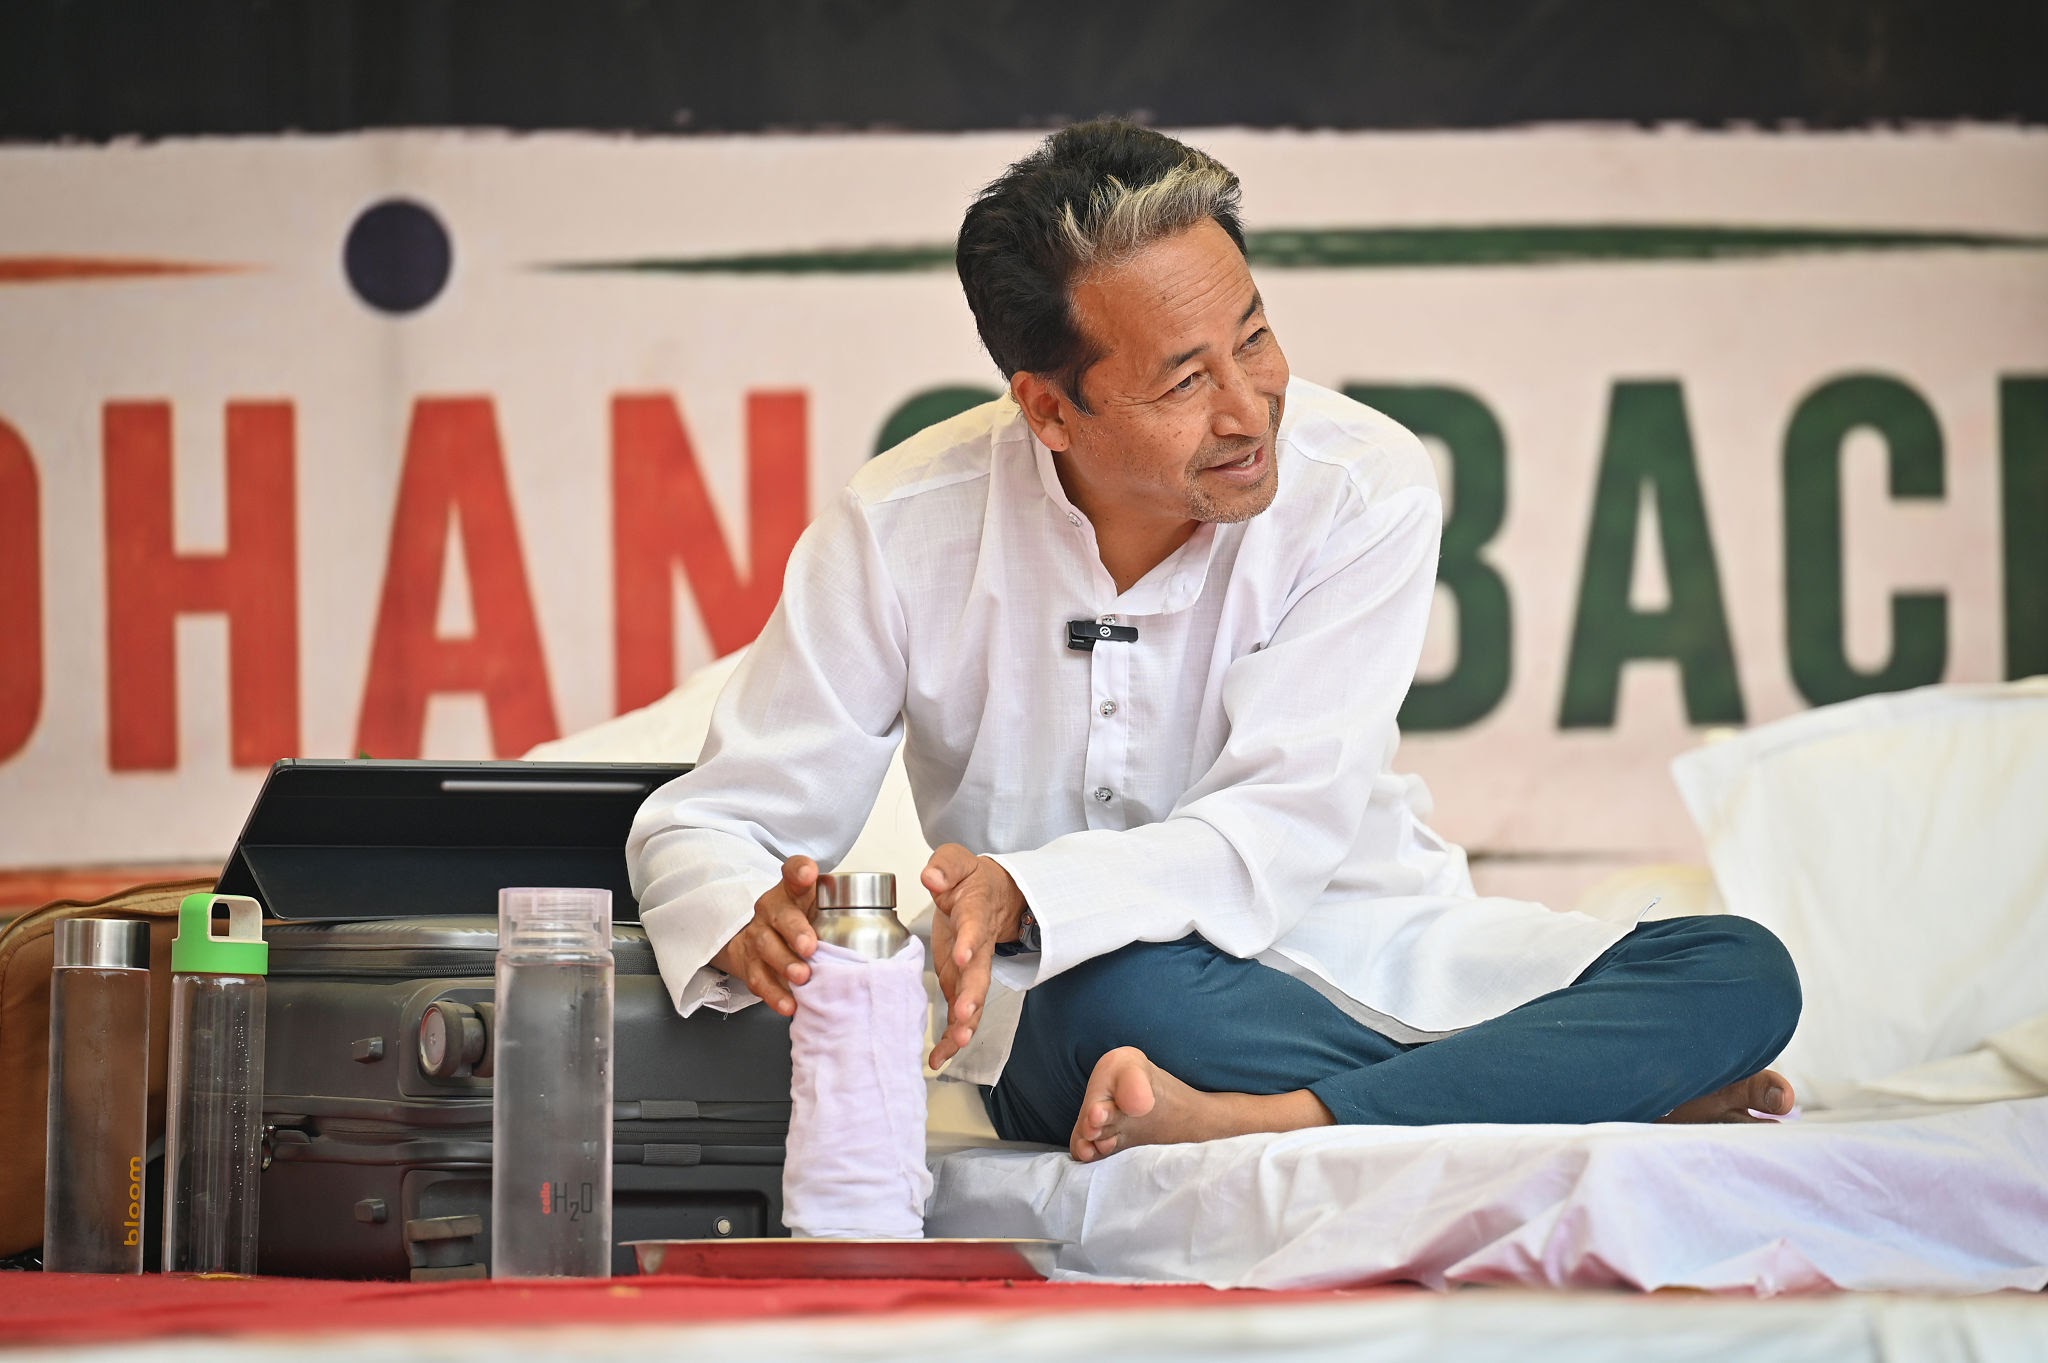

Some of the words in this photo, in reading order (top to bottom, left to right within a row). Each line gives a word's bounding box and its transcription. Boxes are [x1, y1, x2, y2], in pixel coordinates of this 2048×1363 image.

[0, 391, 812, 771] HAN
[1340, 371, 2048, 732] BAC
[123, 1156, 142, 1246] bloom
